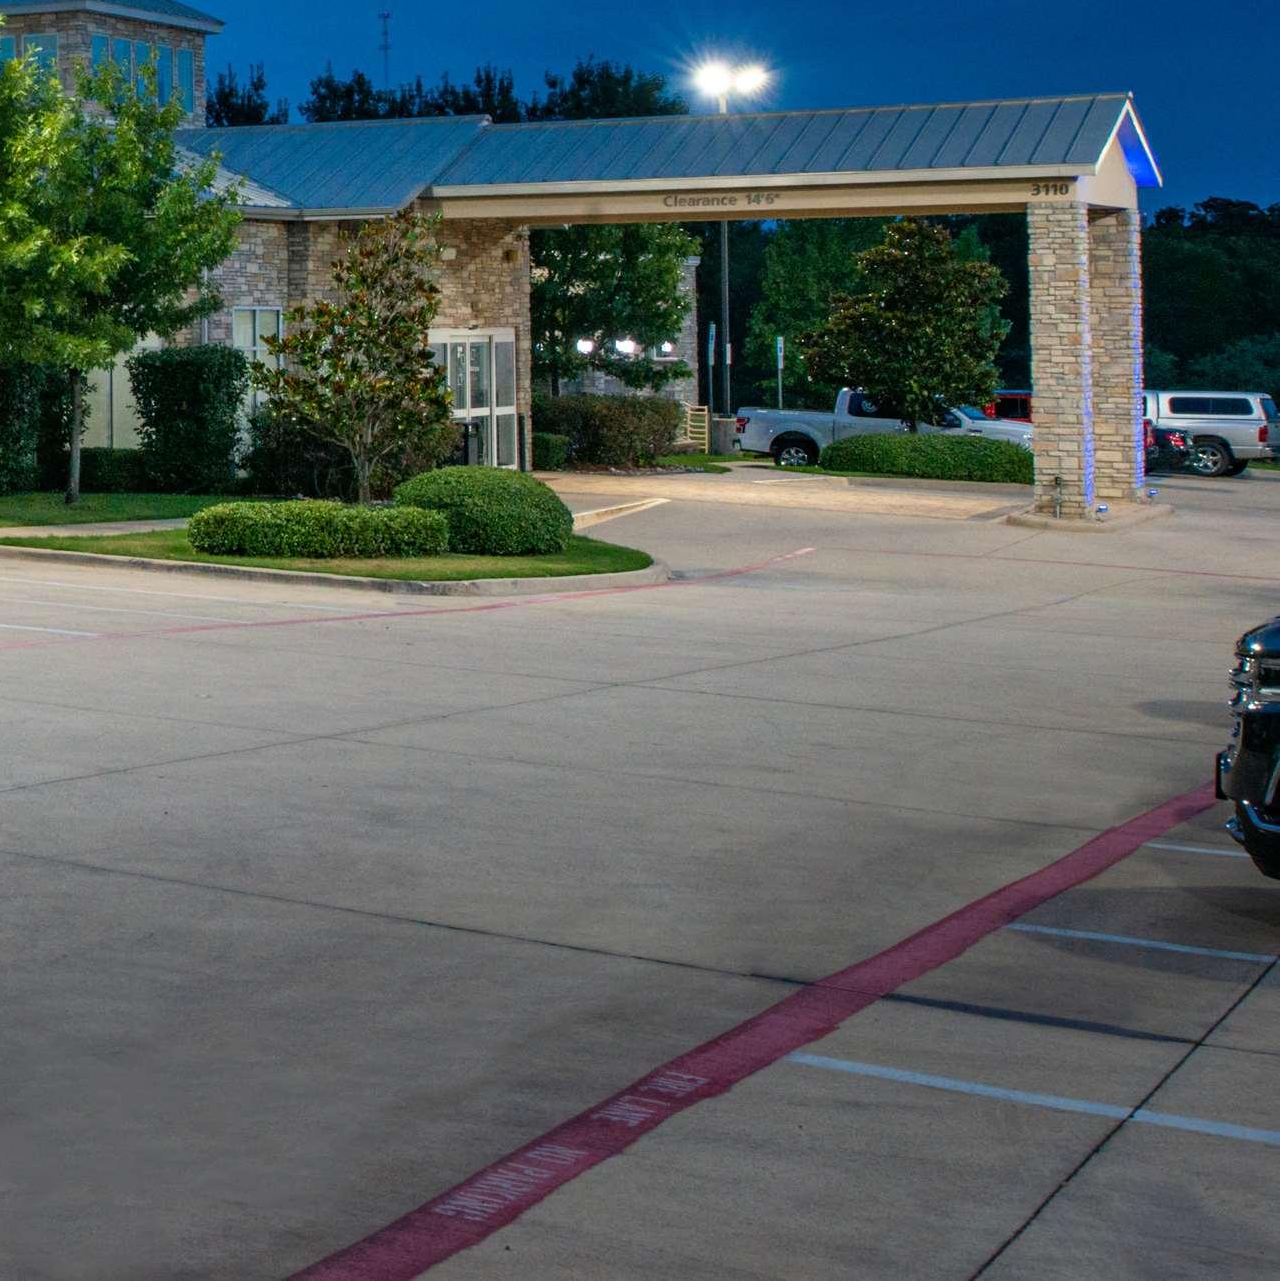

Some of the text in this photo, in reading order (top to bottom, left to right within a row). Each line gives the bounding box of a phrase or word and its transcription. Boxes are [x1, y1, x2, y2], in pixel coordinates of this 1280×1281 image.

[1031, 183, 1069, 196] 3110
[663, 194, 738, 208] Clearance
[432, 1161, 557, 1222] PARKING
